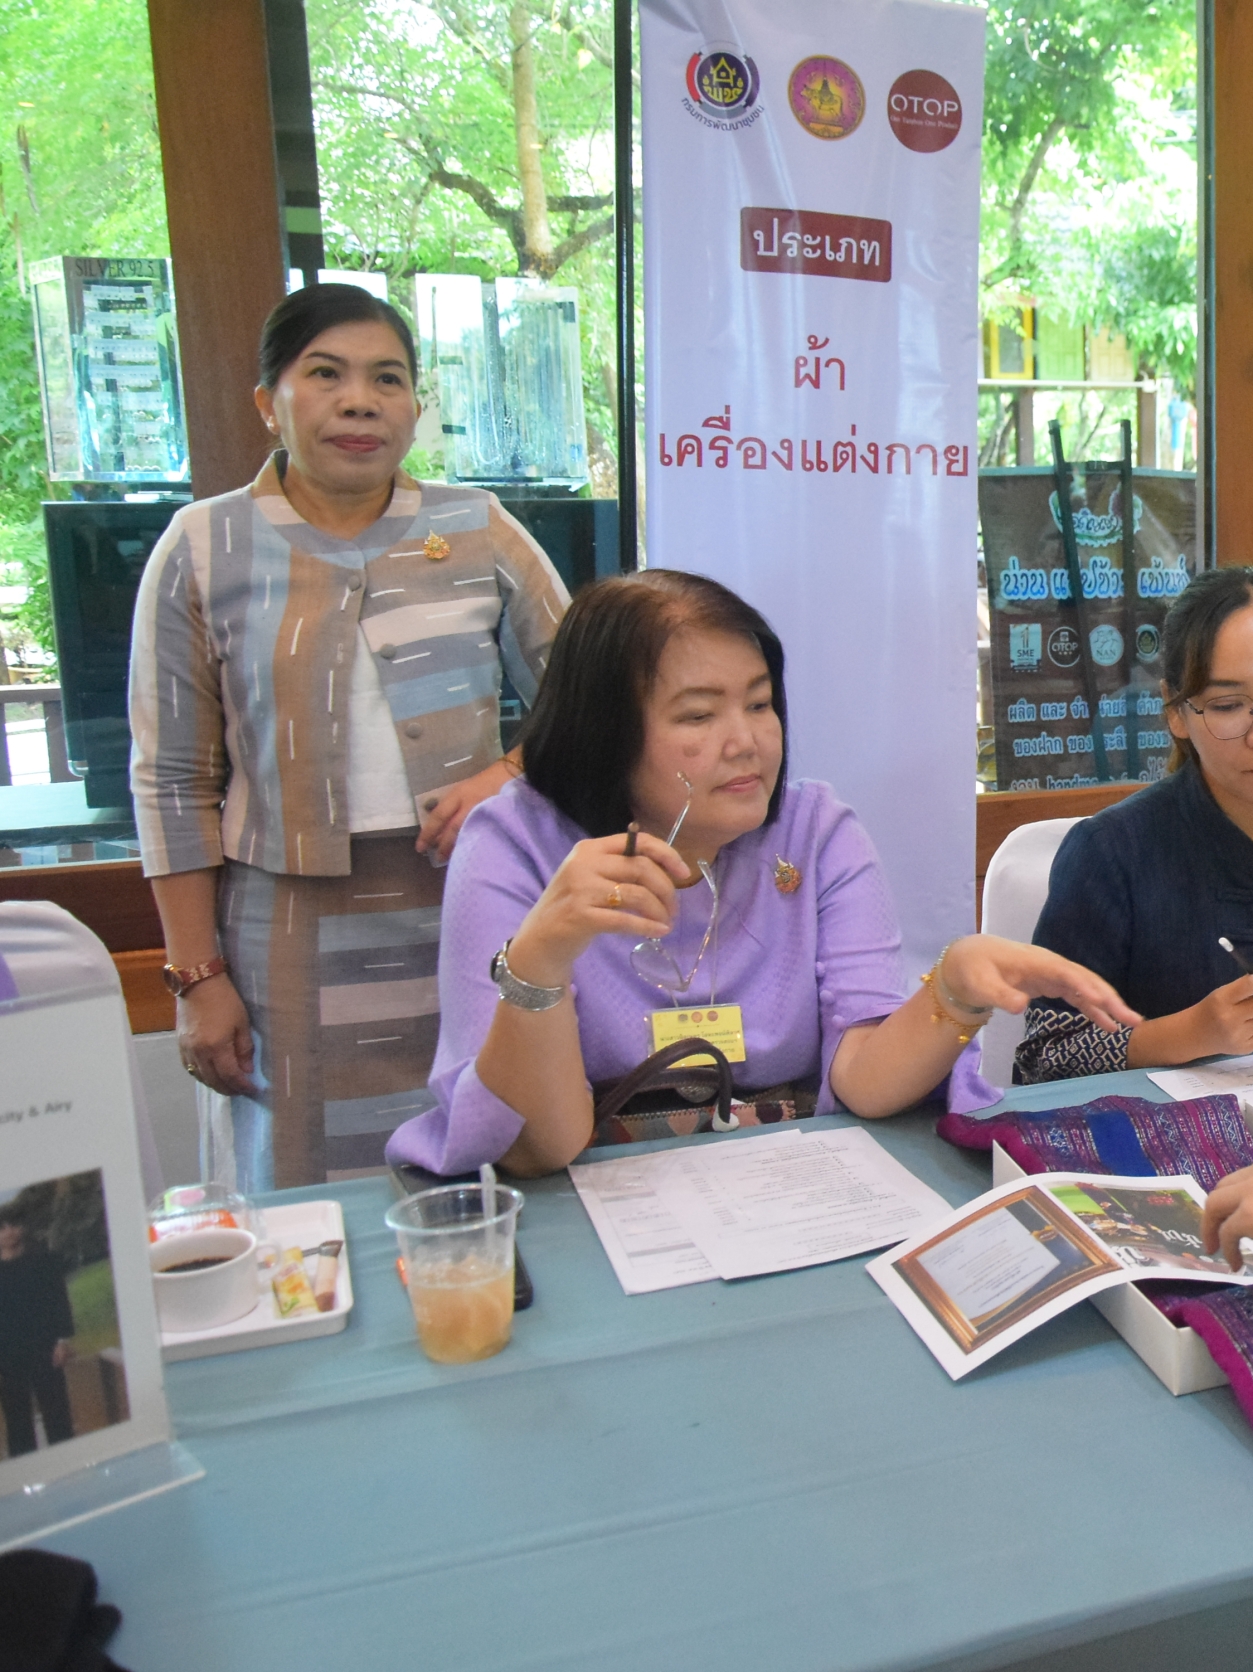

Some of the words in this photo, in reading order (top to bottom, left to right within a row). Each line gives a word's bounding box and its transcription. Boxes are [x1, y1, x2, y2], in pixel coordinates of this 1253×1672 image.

[681, 96, 765, 132] กรมการพัฒนาชุมชน
[890, 94, 959, 117] OTOP
[753, 217, 880, 266] ประเภท
[75, 258, 126, 278] SILVER
[794, 334, 846, 391] ผ้า
[658, 404, 969, 477] เครื่องแต่งกาย
[1016, 649, 1035, 658] SME
[1096, 649, 1117, 657] NAN
[1008, 698, 1036, 722] ผลิต
[1040, 702, 1067, 720] และ
[1013, 731, 1064, 757] ของฝาก
